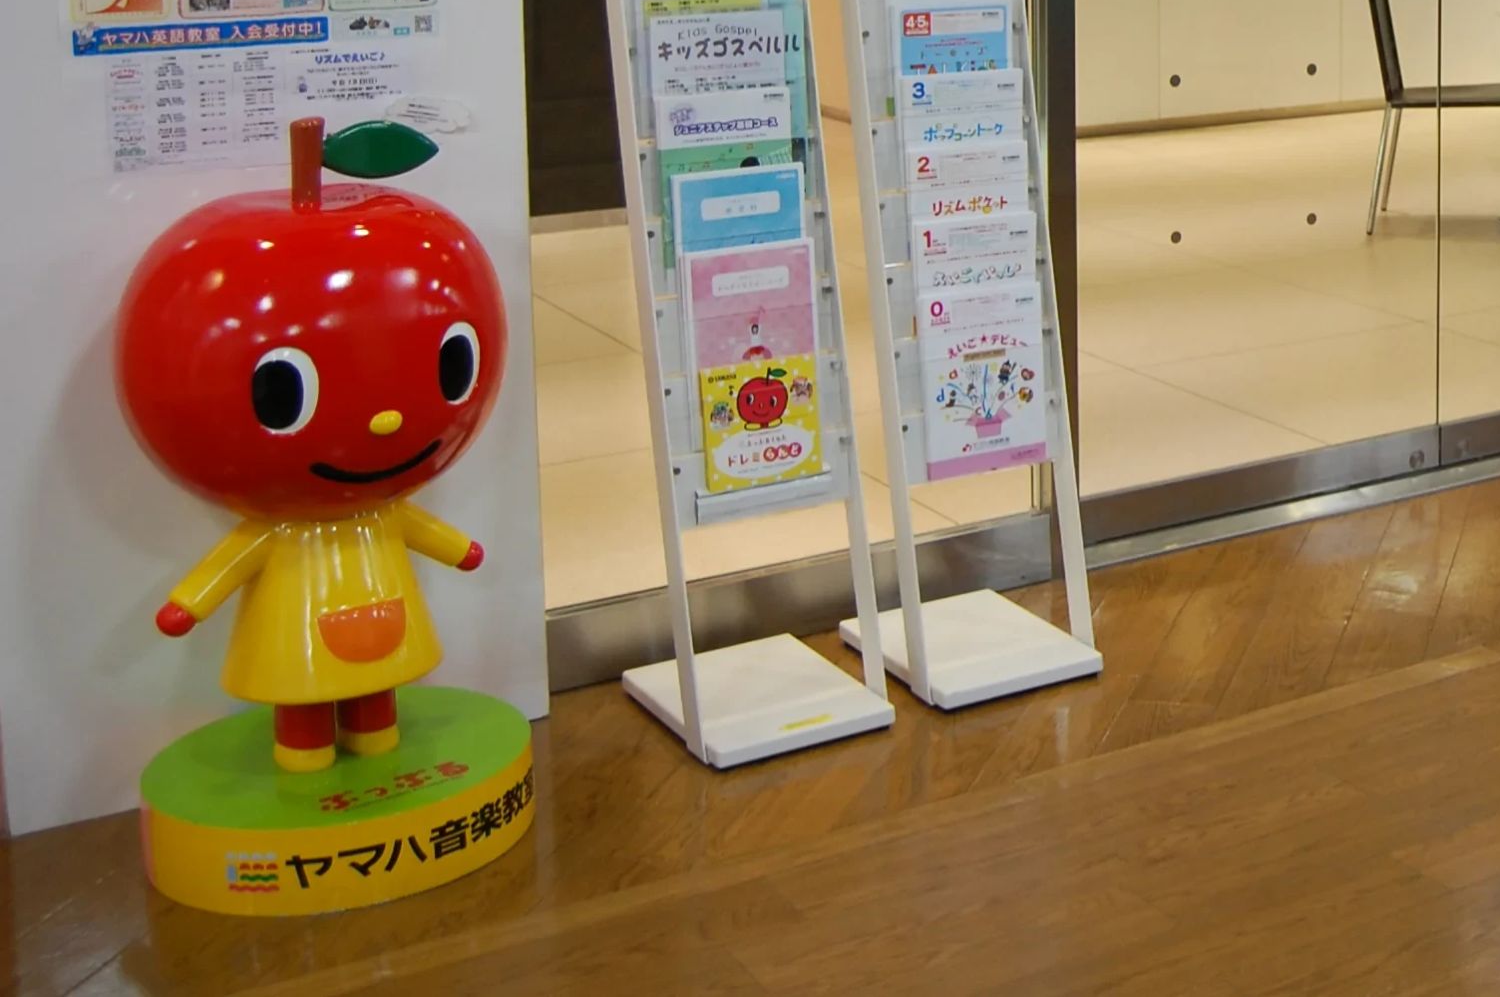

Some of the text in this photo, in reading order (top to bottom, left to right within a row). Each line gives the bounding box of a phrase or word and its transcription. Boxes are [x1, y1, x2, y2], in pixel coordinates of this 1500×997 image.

[102, 26, 221, 46] ヤマハ英語教室
[715, 23, 758, 38] Gospel
[658, 36, 781, 62] キッズゴスペル
[912, 82, 926, 99] 3
[917, 156, 931, 173] 2
[923, 230, 932, 248] 1
